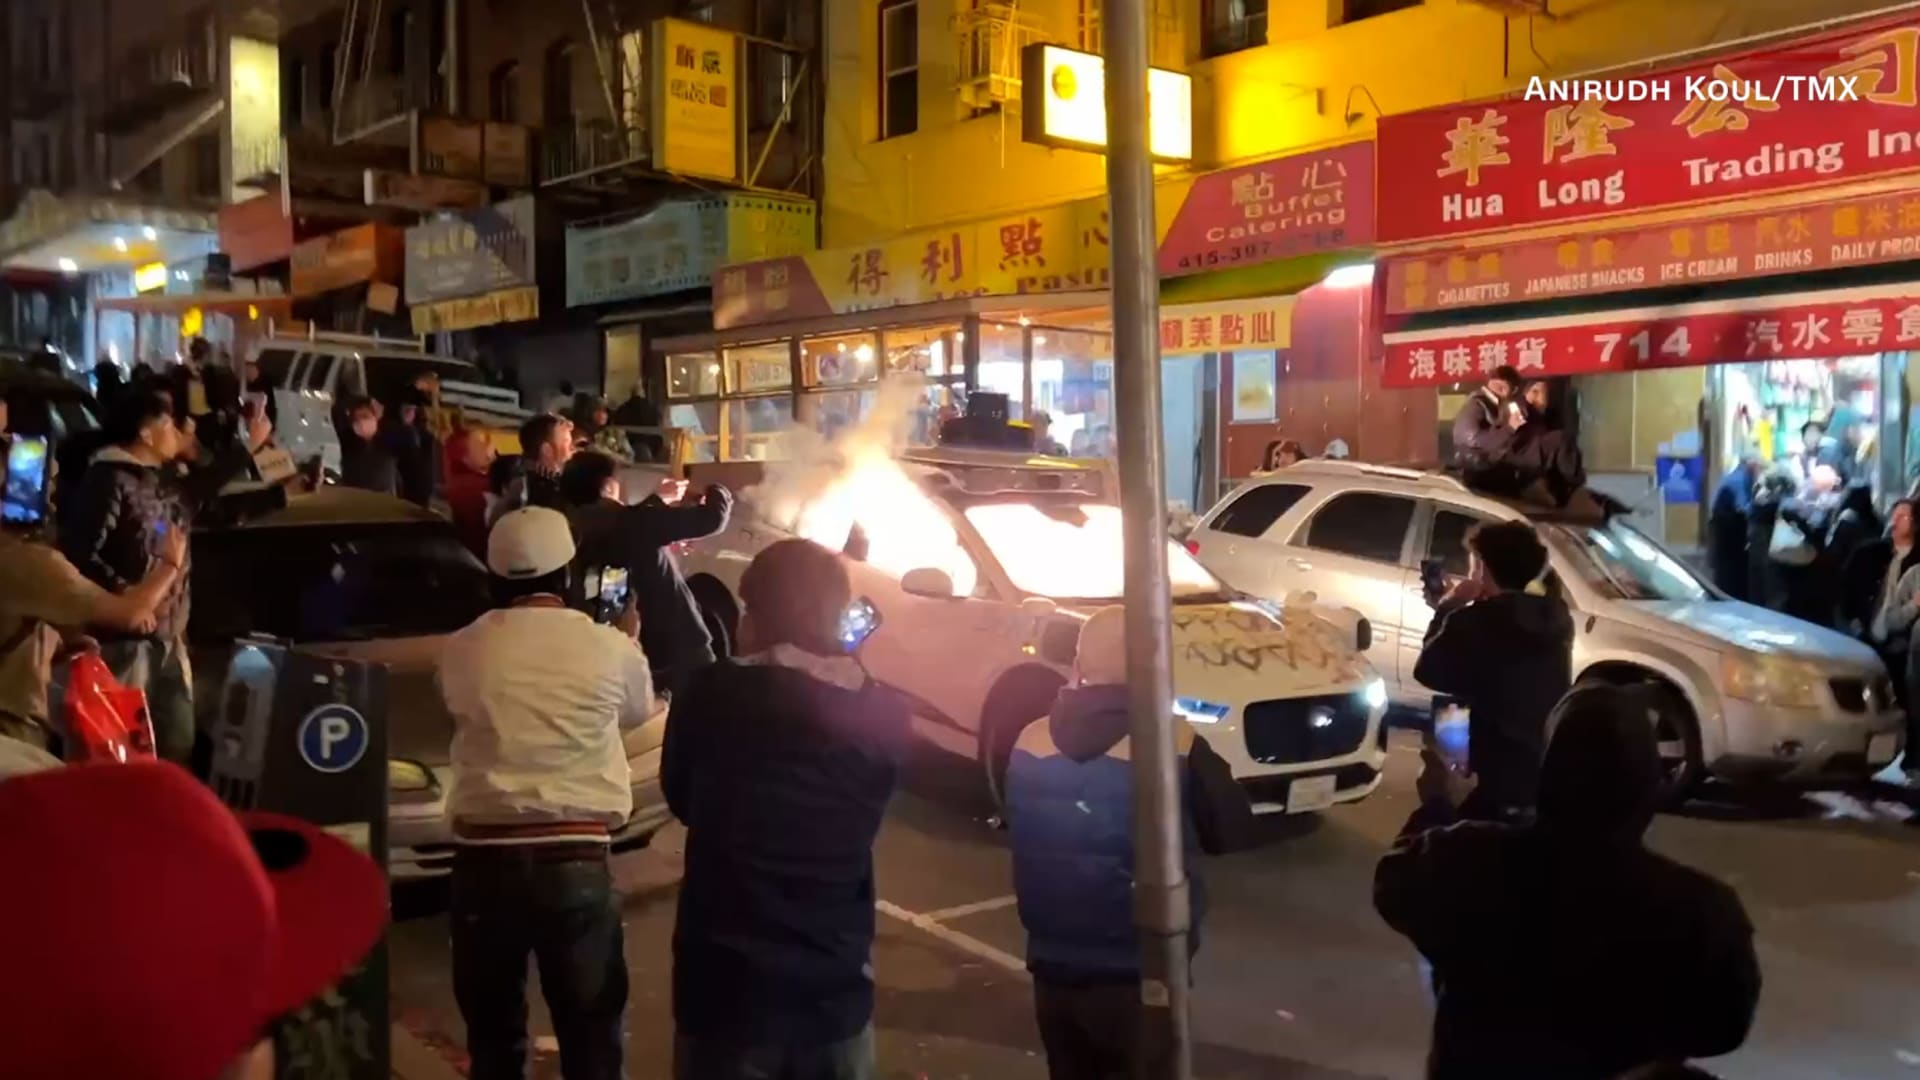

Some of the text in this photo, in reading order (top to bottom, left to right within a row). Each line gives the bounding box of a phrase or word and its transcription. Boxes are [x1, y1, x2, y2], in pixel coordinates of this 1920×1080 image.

[1436, 27, 1920, 187] 華隆公司
[1244, 188, 1345, 219] Buffet
[1442, 193, 1504, 223] Hua
[1538, 169, 1625, 208] Long
[1682, 141, 1844, 186] Trading
[1206, 207, 1346, 243] Catering
[1524, 272, 1588, 296] JAPANESE
[1591, 266, 1646, 288] SNACKS
[1661, 263, 1683, 281] ICE
[1687, 256, 1738, 278] CREAM
[1754, 248, 1814, 271] DRINKS
[1831, 240, 1876, 263] DAILY
[1593, 325, 1692, 363] 714
[320, 716, 350, 760] P
